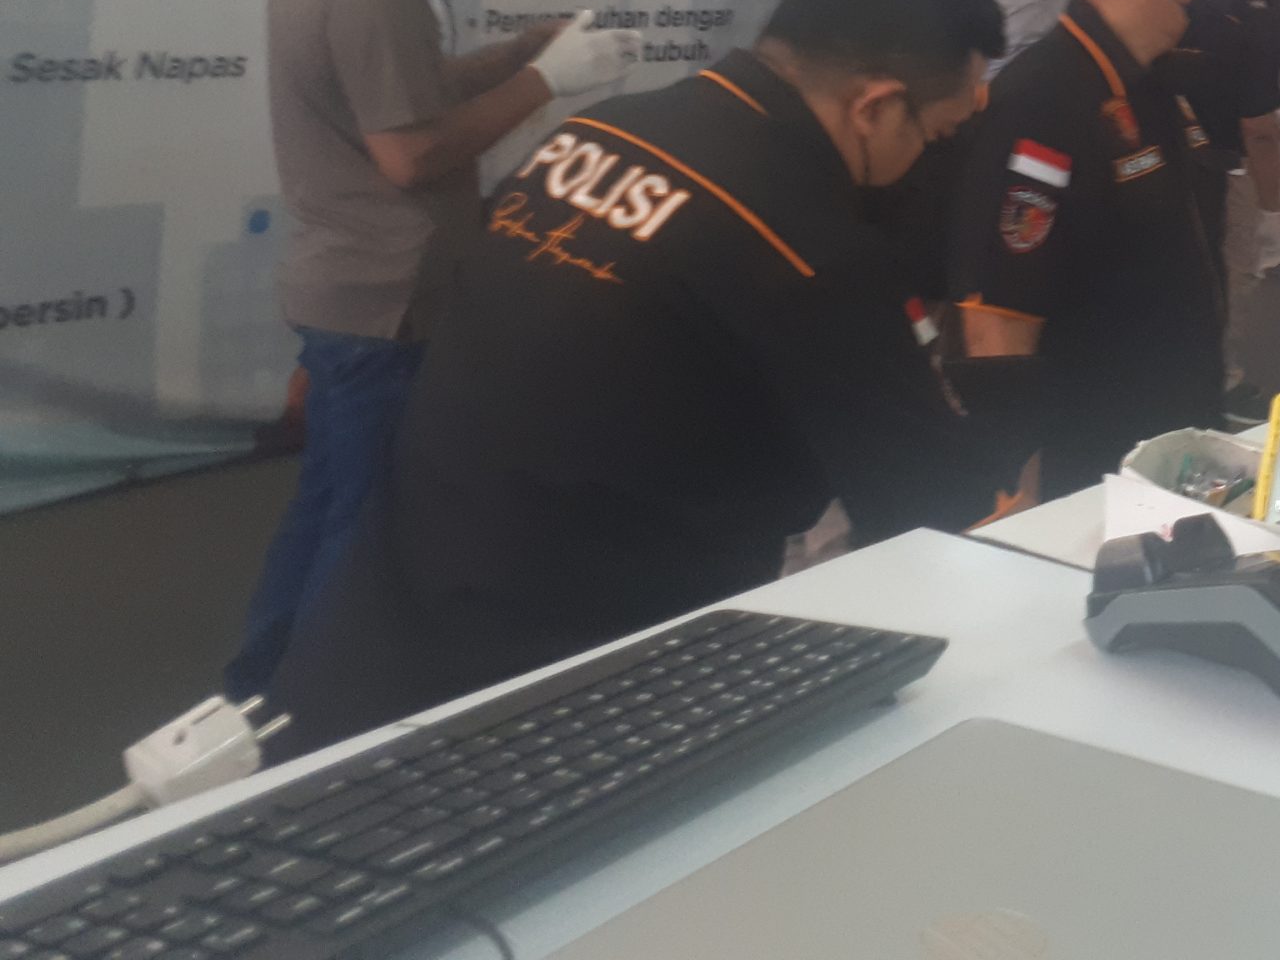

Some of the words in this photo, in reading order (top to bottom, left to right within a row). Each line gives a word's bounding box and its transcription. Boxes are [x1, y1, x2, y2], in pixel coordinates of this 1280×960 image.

[9, 50, 128, 83] Sesak
[134, 50, 248, 84] Napas
[516, 131, 694, 242] POLISI
